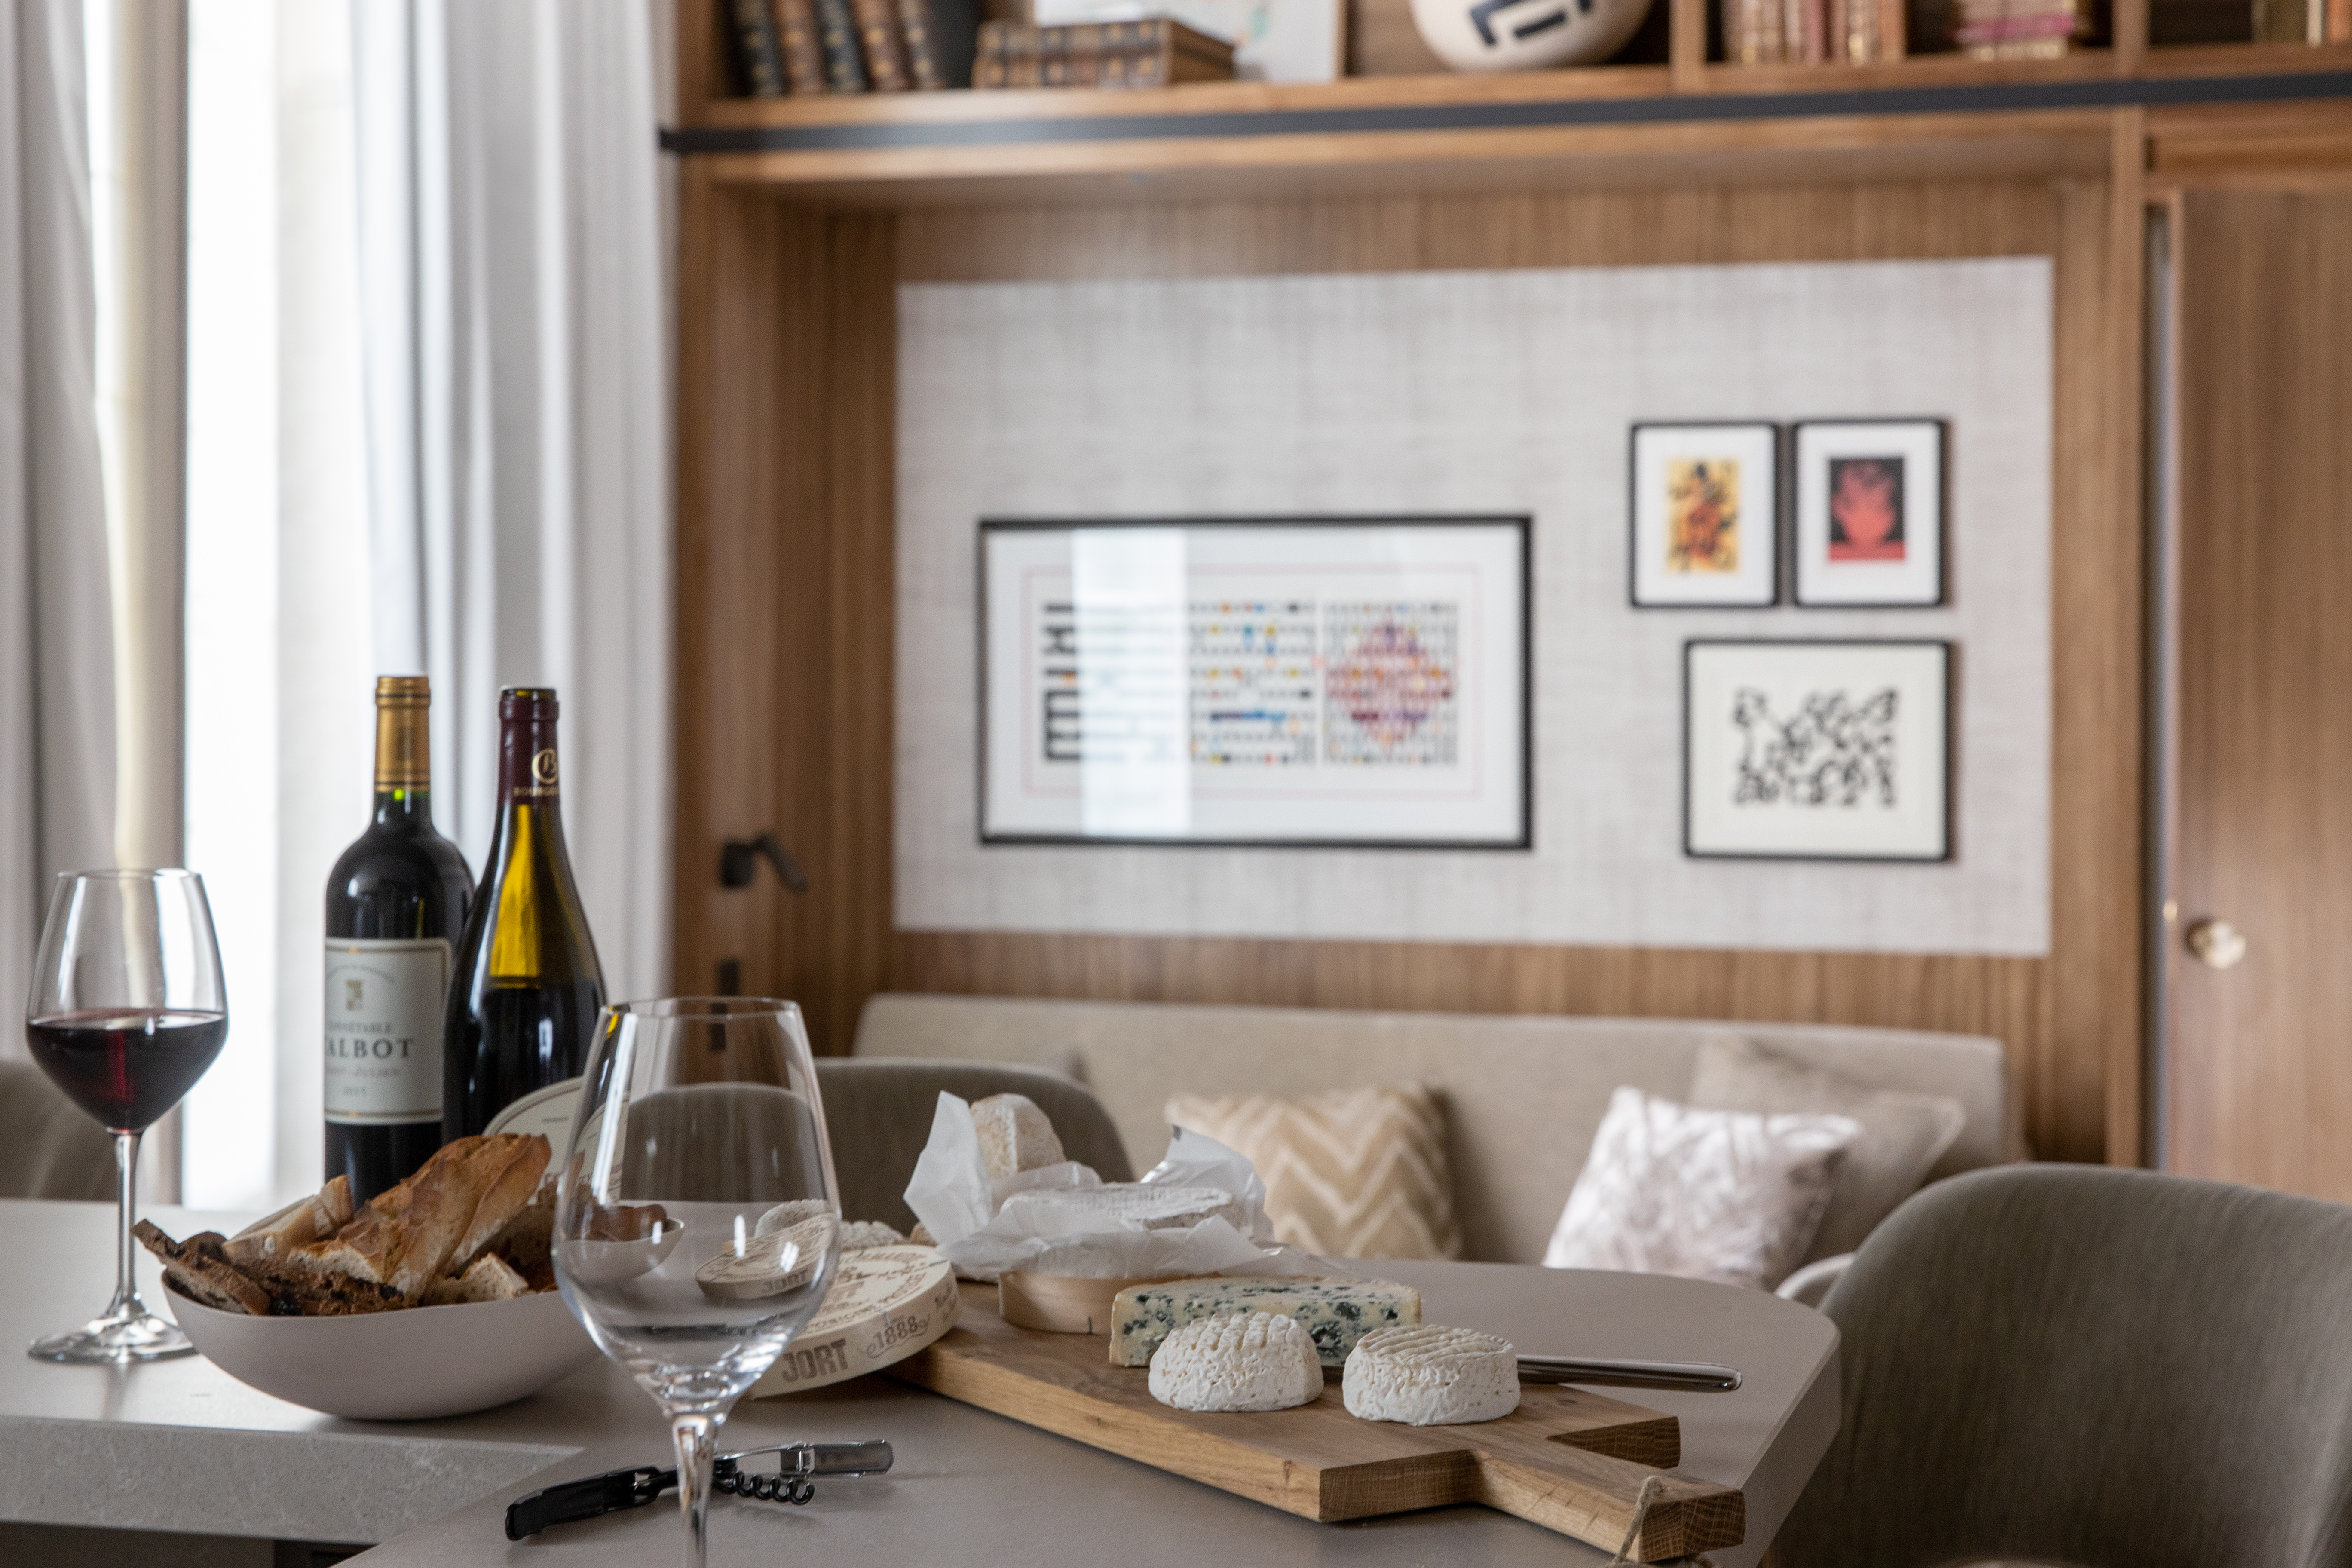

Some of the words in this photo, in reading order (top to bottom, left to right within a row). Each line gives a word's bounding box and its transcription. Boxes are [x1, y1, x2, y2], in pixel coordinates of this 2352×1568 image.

[325, 1037, 415, 1059] ALBOT
[873, 1315, 918, 1349] 1888
[781, 1338, 849, 1383] JORT
